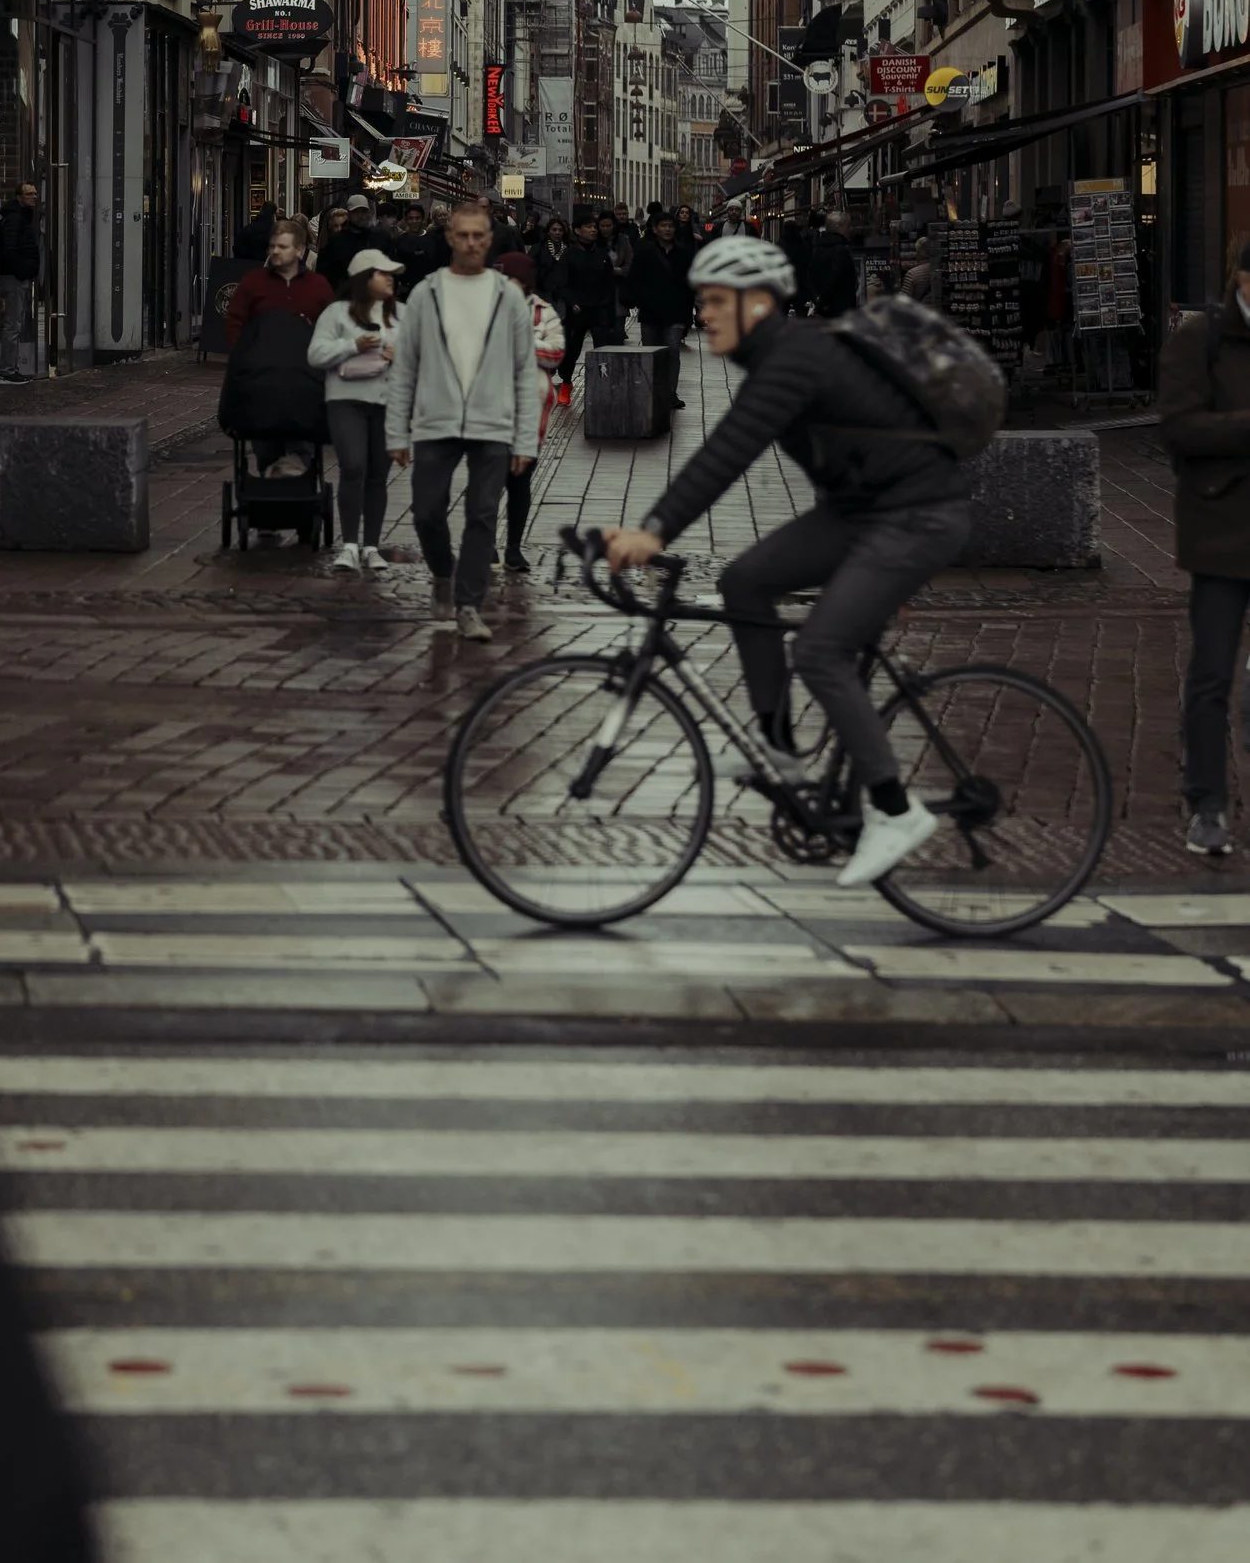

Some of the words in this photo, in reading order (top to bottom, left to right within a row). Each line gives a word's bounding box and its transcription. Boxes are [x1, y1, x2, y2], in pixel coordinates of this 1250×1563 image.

[246, 19, 319, 30] Grill-House
[877, 66, 922, 74] DISCOUNT
[881, 72, 918, 80] Souvenir
[926, 85, 969, 94] SUNSET
[409, 122, 443, 133] CHANGE
